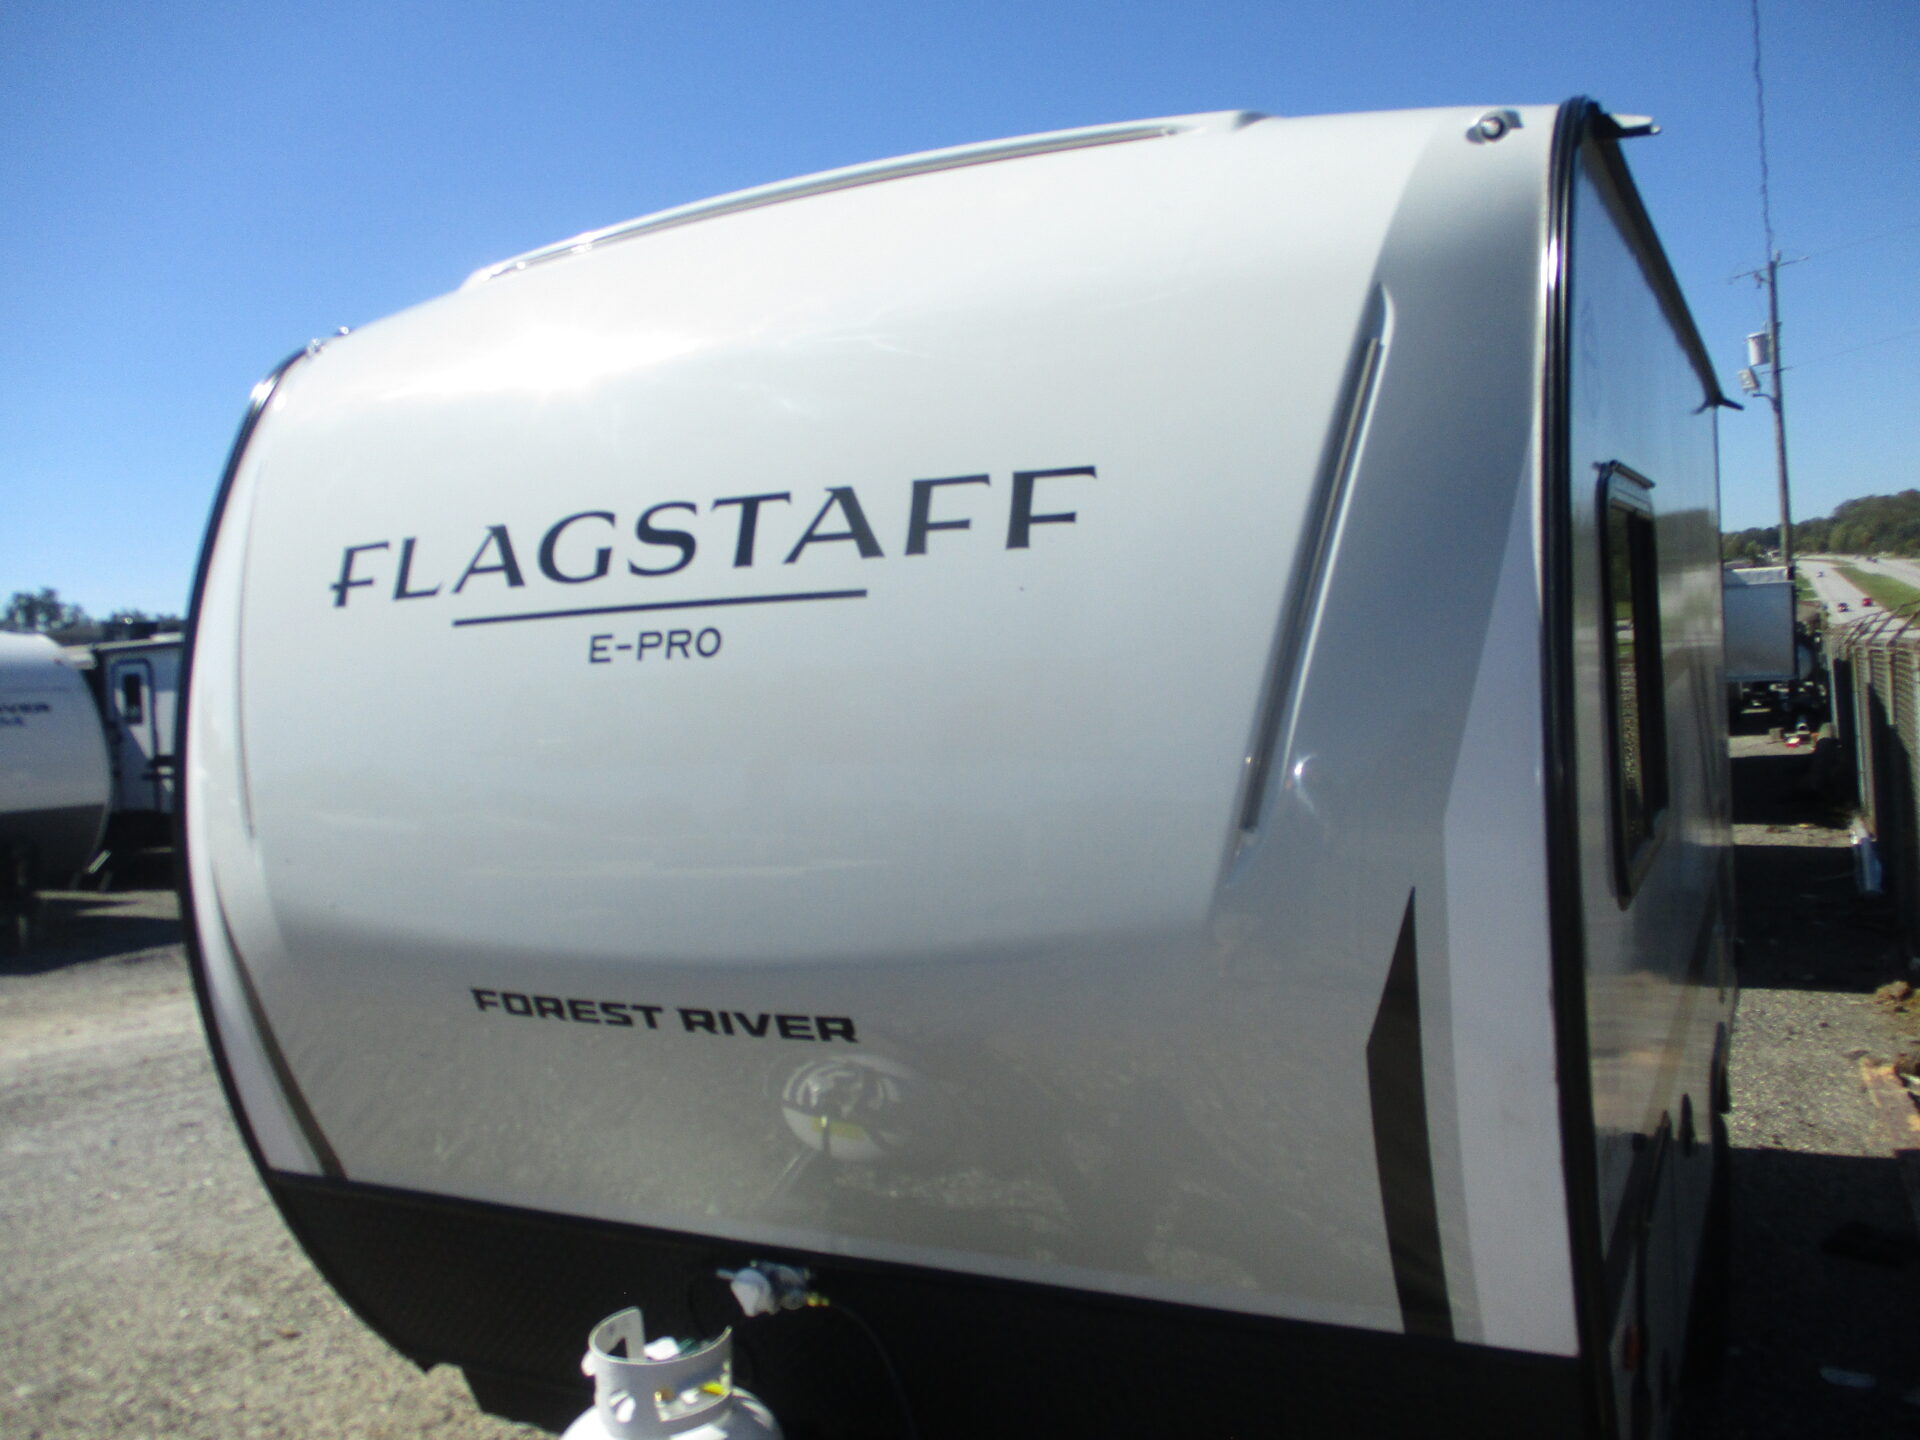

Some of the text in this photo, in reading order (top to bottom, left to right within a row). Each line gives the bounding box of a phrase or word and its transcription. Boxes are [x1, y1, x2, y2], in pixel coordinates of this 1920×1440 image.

[331, 465, 1098, 608] FLAGSTAFF
[588, 626, 723, 665] E-PRO
[471, 987, 859, 1044] FOREST RIVER
